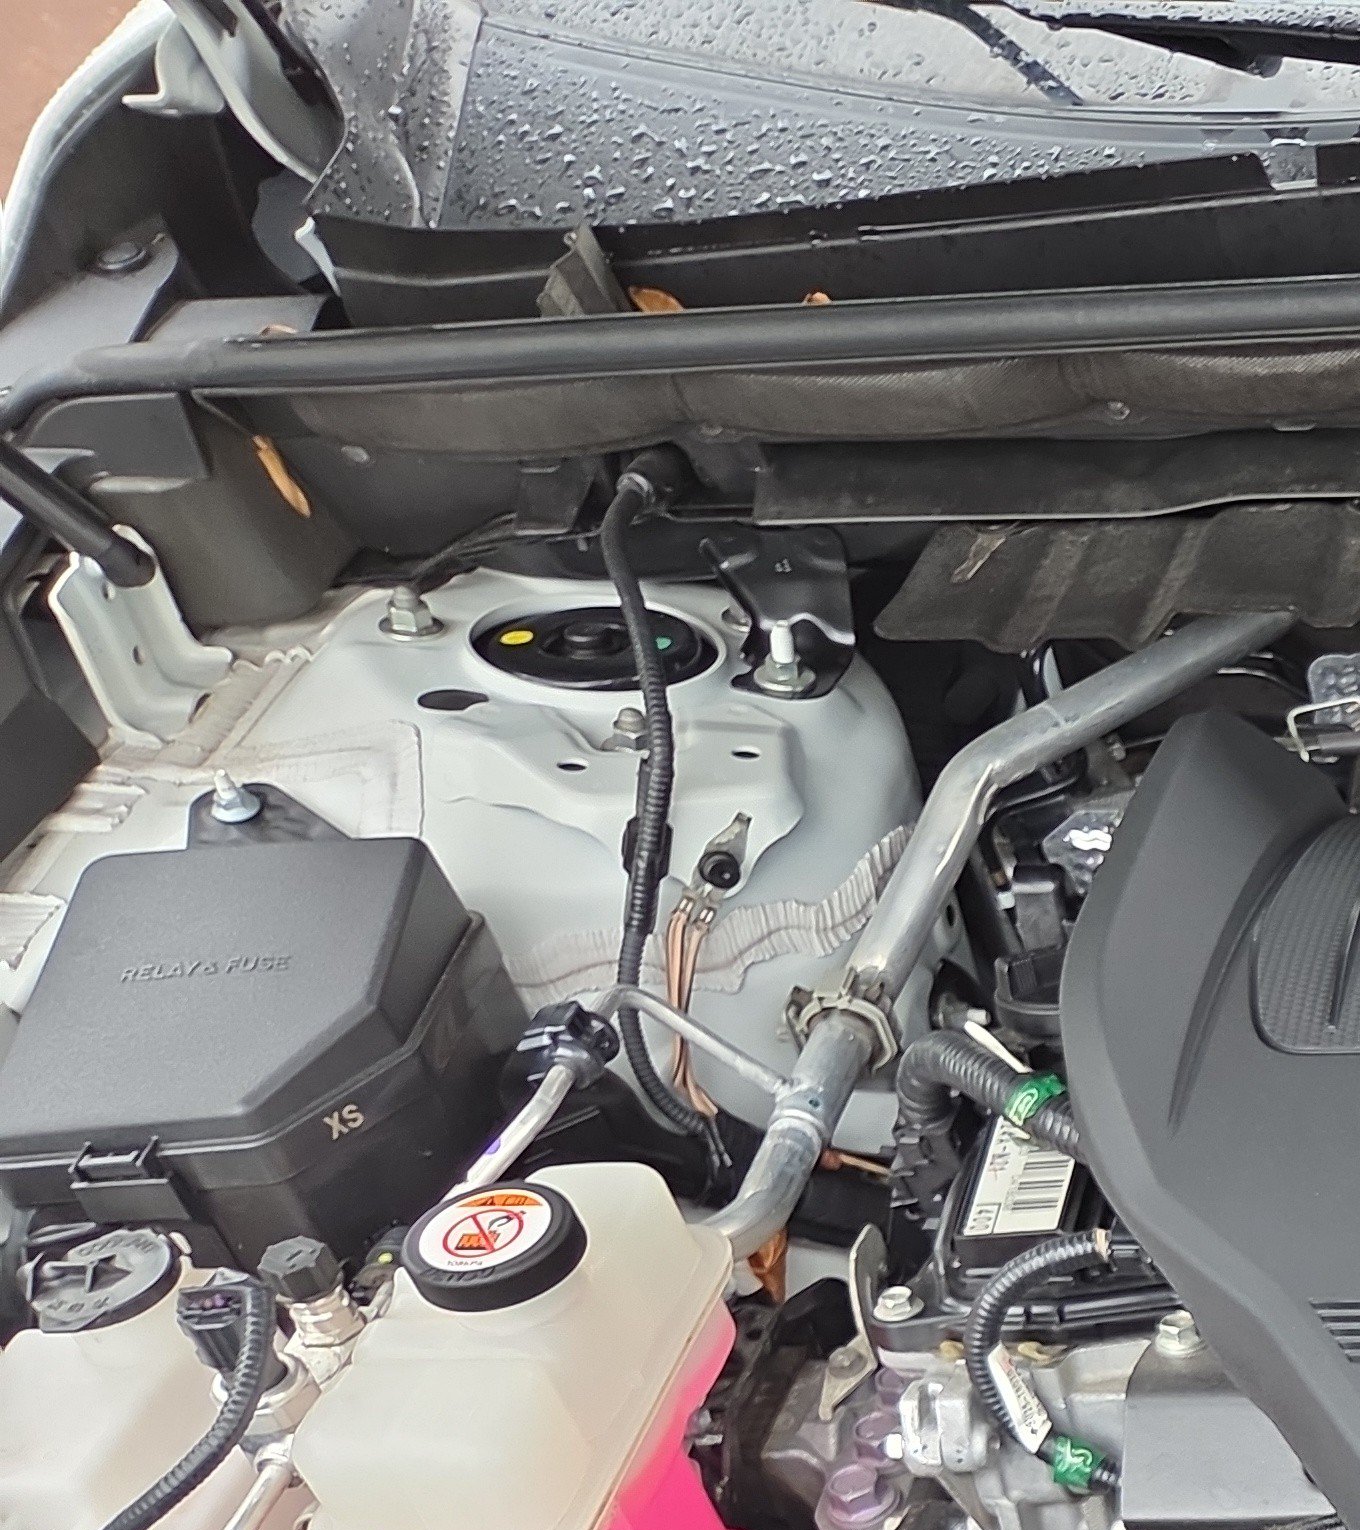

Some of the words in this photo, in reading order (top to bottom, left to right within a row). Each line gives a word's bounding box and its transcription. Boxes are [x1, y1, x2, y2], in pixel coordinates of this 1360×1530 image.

[120, 961, 201, 984] RELAY
[225, 954, 292, 975] FUSE
[322, 1103, 365, 1141] XS
